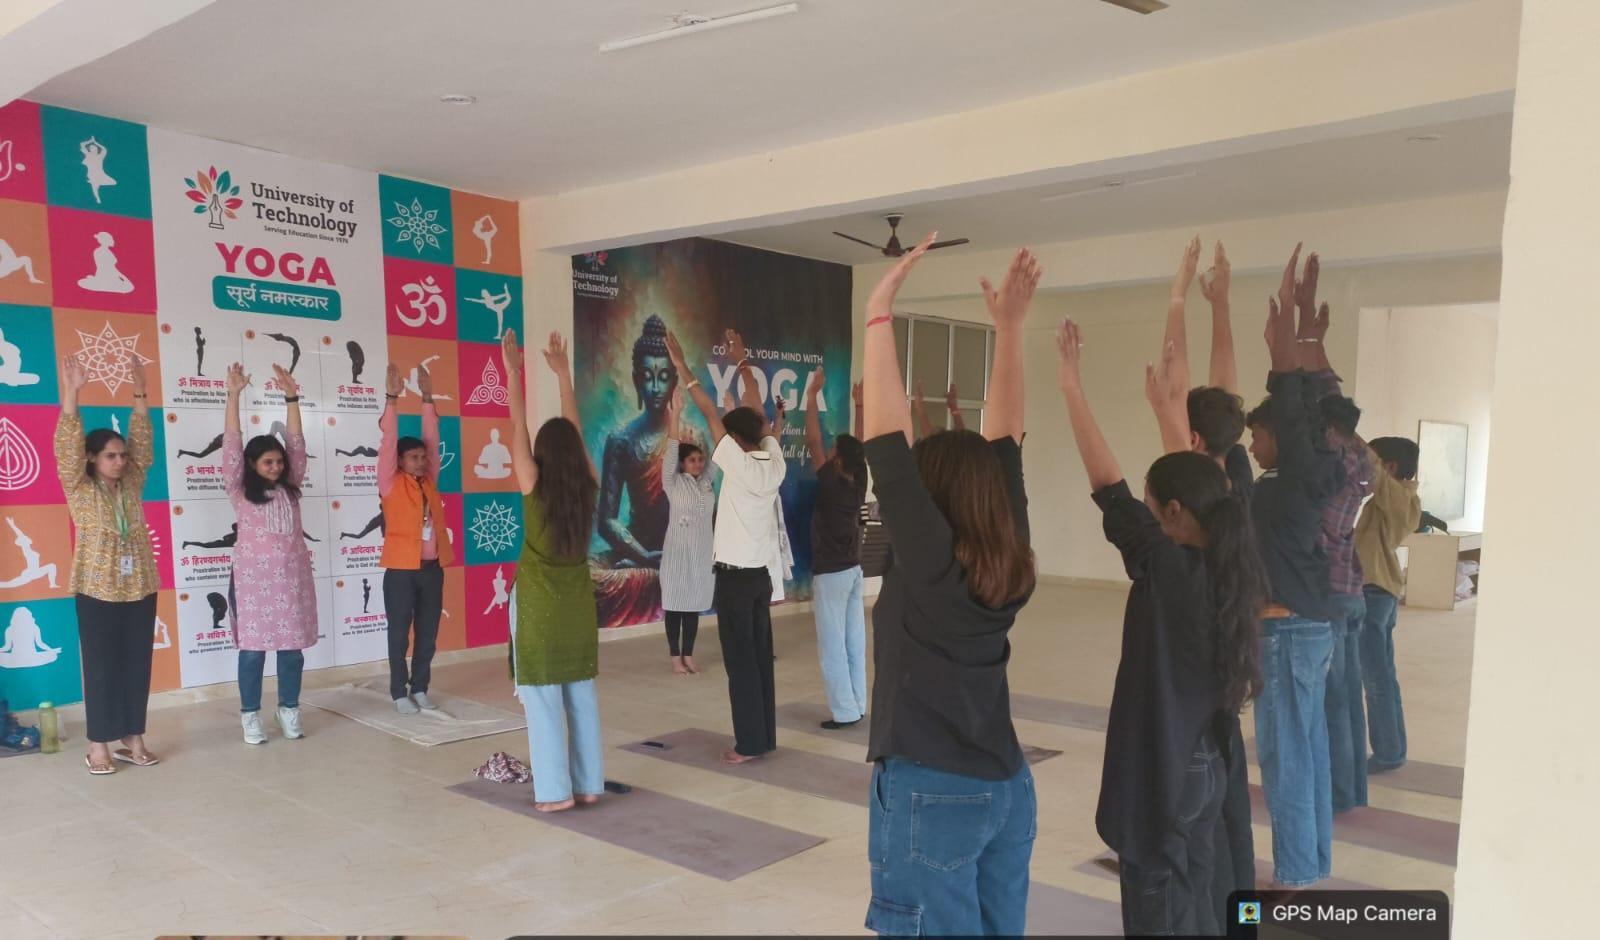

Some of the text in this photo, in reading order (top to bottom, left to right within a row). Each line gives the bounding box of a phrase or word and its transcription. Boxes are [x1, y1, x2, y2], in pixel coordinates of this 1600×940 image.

[251, 182, 354, 214] University of
[252, 202, 357, 238] Technology
[264, 226, 287, 235] Serving
[288, 229, 318, 239] Education
[319, 234, 334, 242] Since
[215, 242, 336, 286] YOGA
[573, 279, 619, 297] Technology
[610, 274, 618, 283] of
[226, 283, 329, 311] सूर्य नमस्कार
[712, 344, 823, 364] COOL YOUR MIND WITH
[706, 363, 827, 412] YOGA
